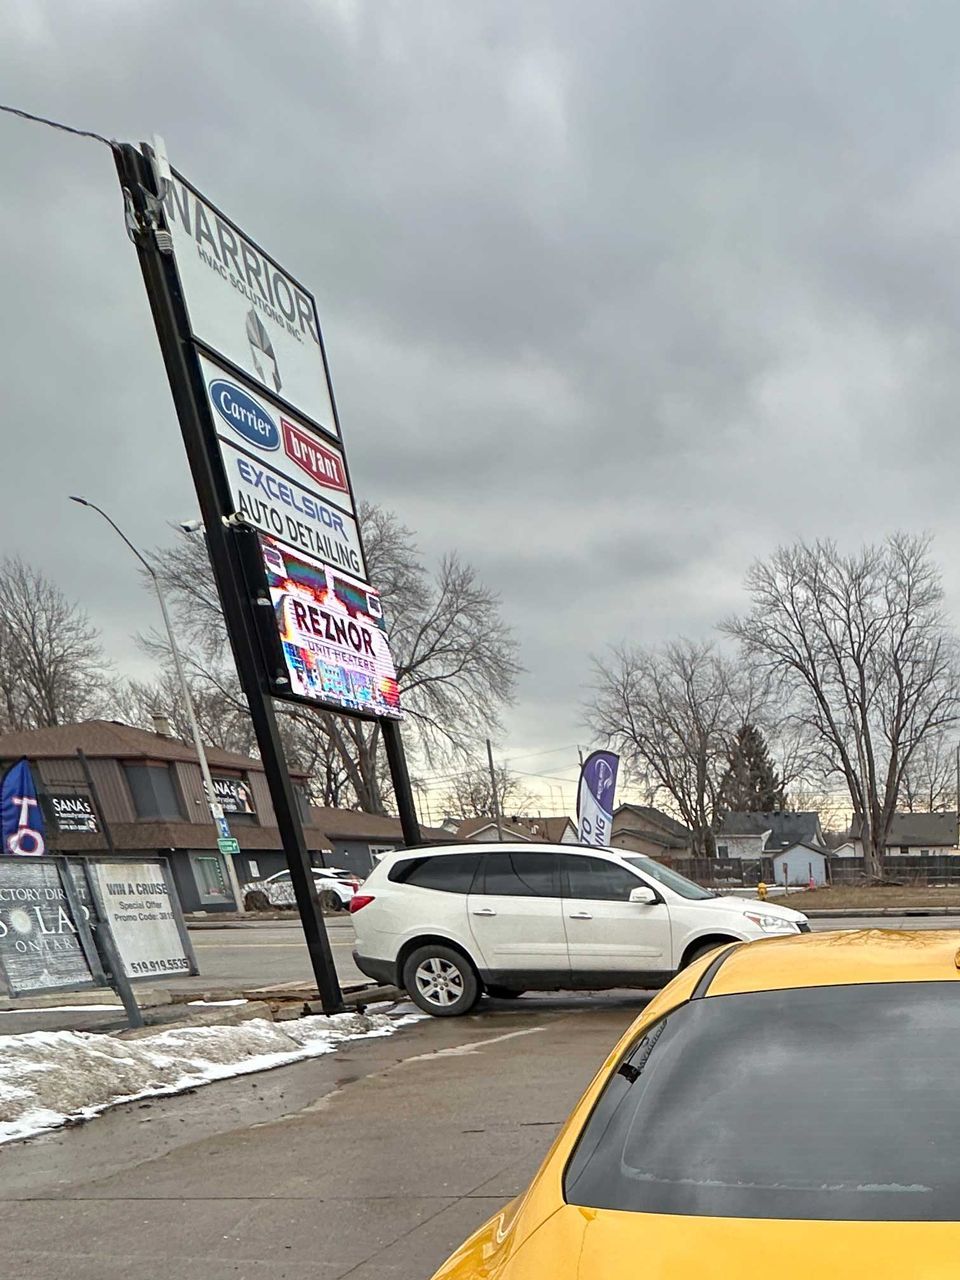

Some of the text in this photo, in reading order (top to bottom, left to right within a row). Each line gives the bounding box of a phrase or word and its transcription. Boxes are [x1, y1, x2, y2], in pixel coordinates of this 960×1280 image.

[163, 181, 320, 345] WARRIOR
[197, 245, 228, 281] HVAC
[230, 274, 286, 329] SOLUTIONS
[220, 390, 272, 438] Carrier
[290, 431, 341, 486] bryant
[237, 457, 349, 543] EXCELSIOR
[238, 489, 361, 574] AUTO DETAILING
[293, 598, 376, 657] REZNOR
[44, 888, 86, 900] DIRT
